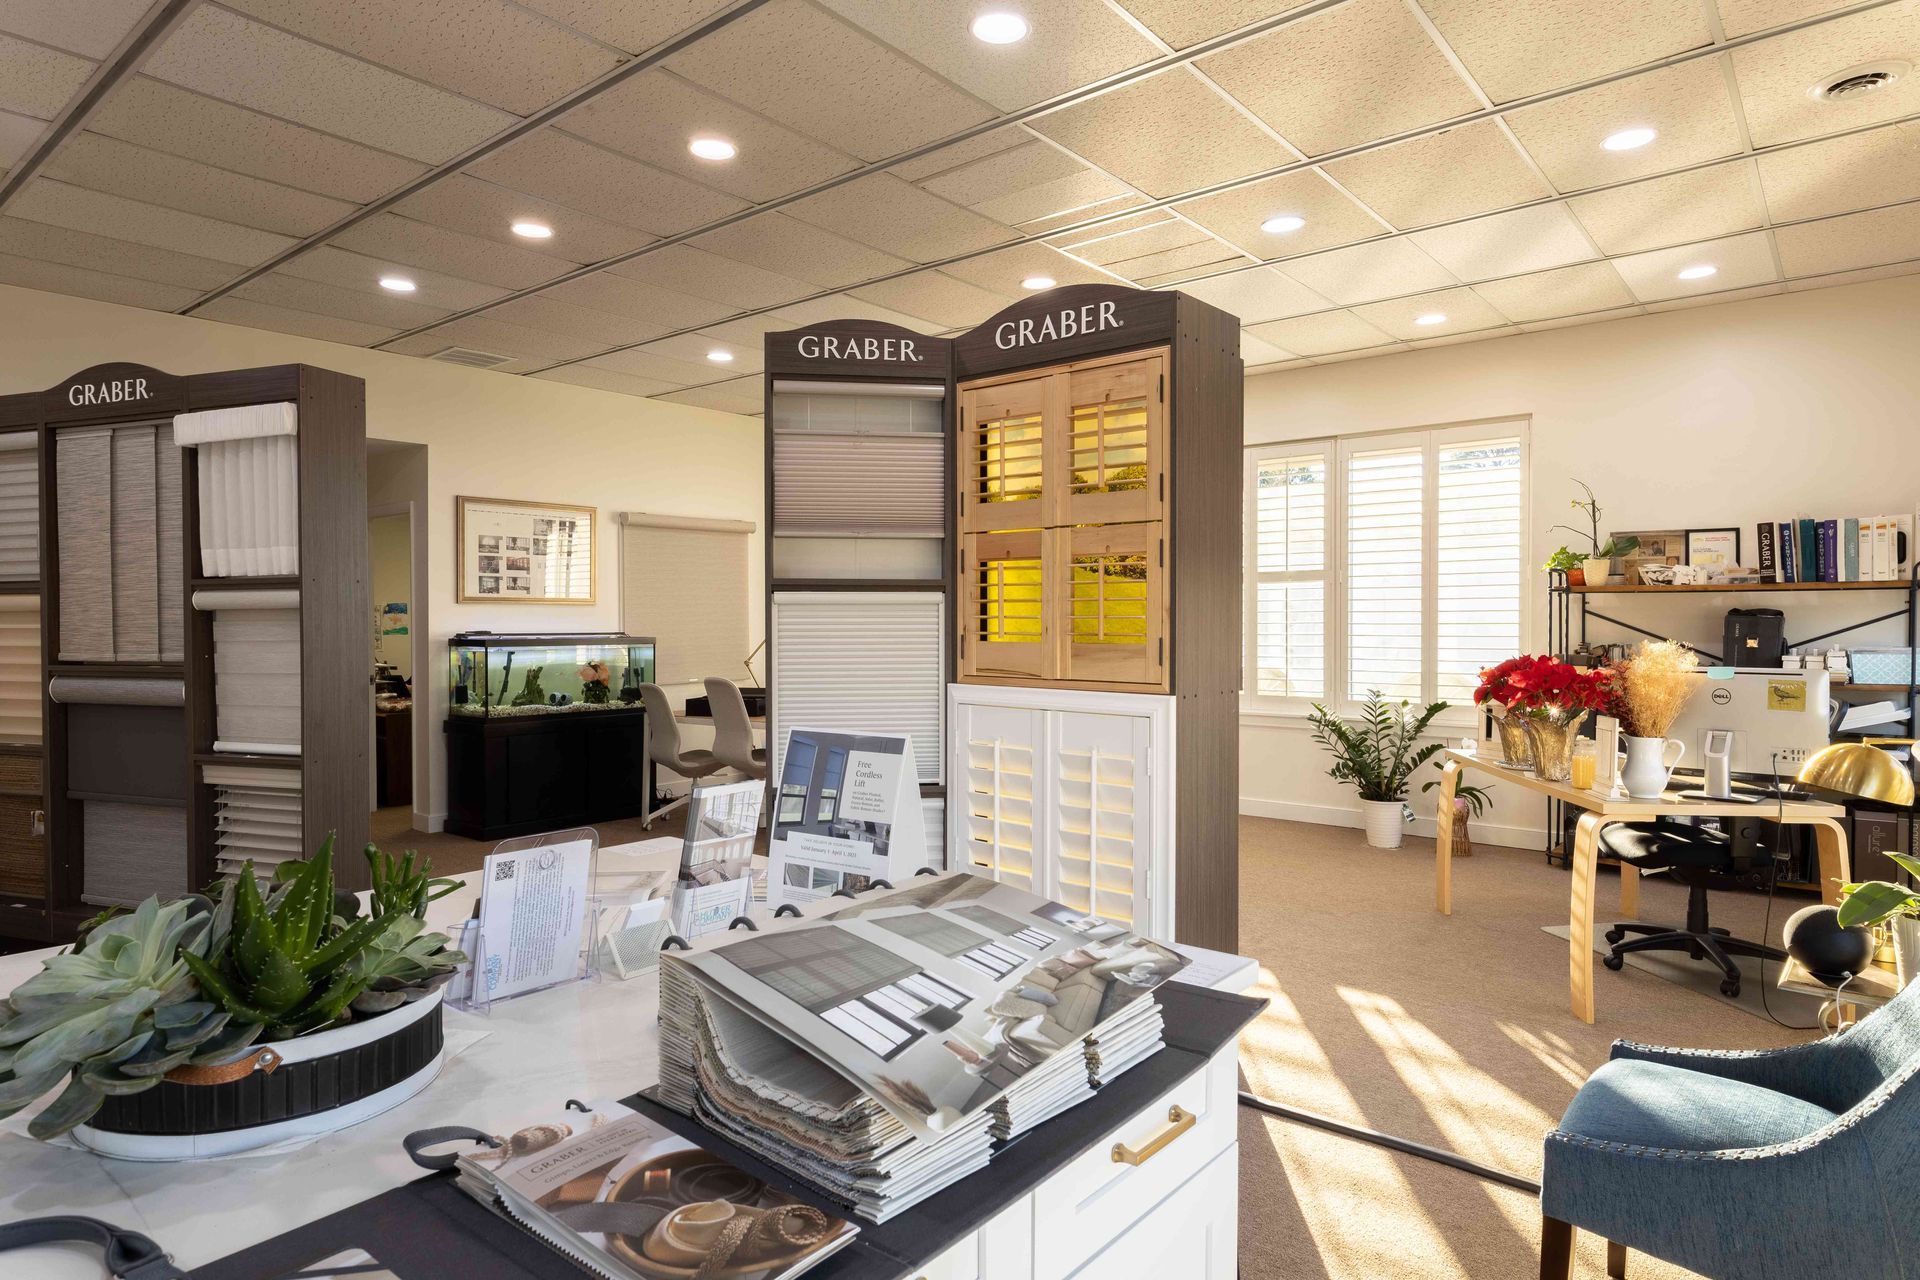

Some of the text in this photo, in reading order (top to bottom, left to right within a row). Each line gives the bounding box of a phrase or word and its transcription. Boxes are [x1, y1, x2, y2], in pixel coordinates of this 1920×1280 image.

[994, 301, 1120, 350] GRABER
[798, 335, 918, 362] GRABER
[68, 378, 149, 406] GRABER
[1761, 533, 1773, 567] GRABER
[856, 770, 883, 779] Cordless
[857, 760, 872, 769] Free
[854, 779, 866, 788] Lift
